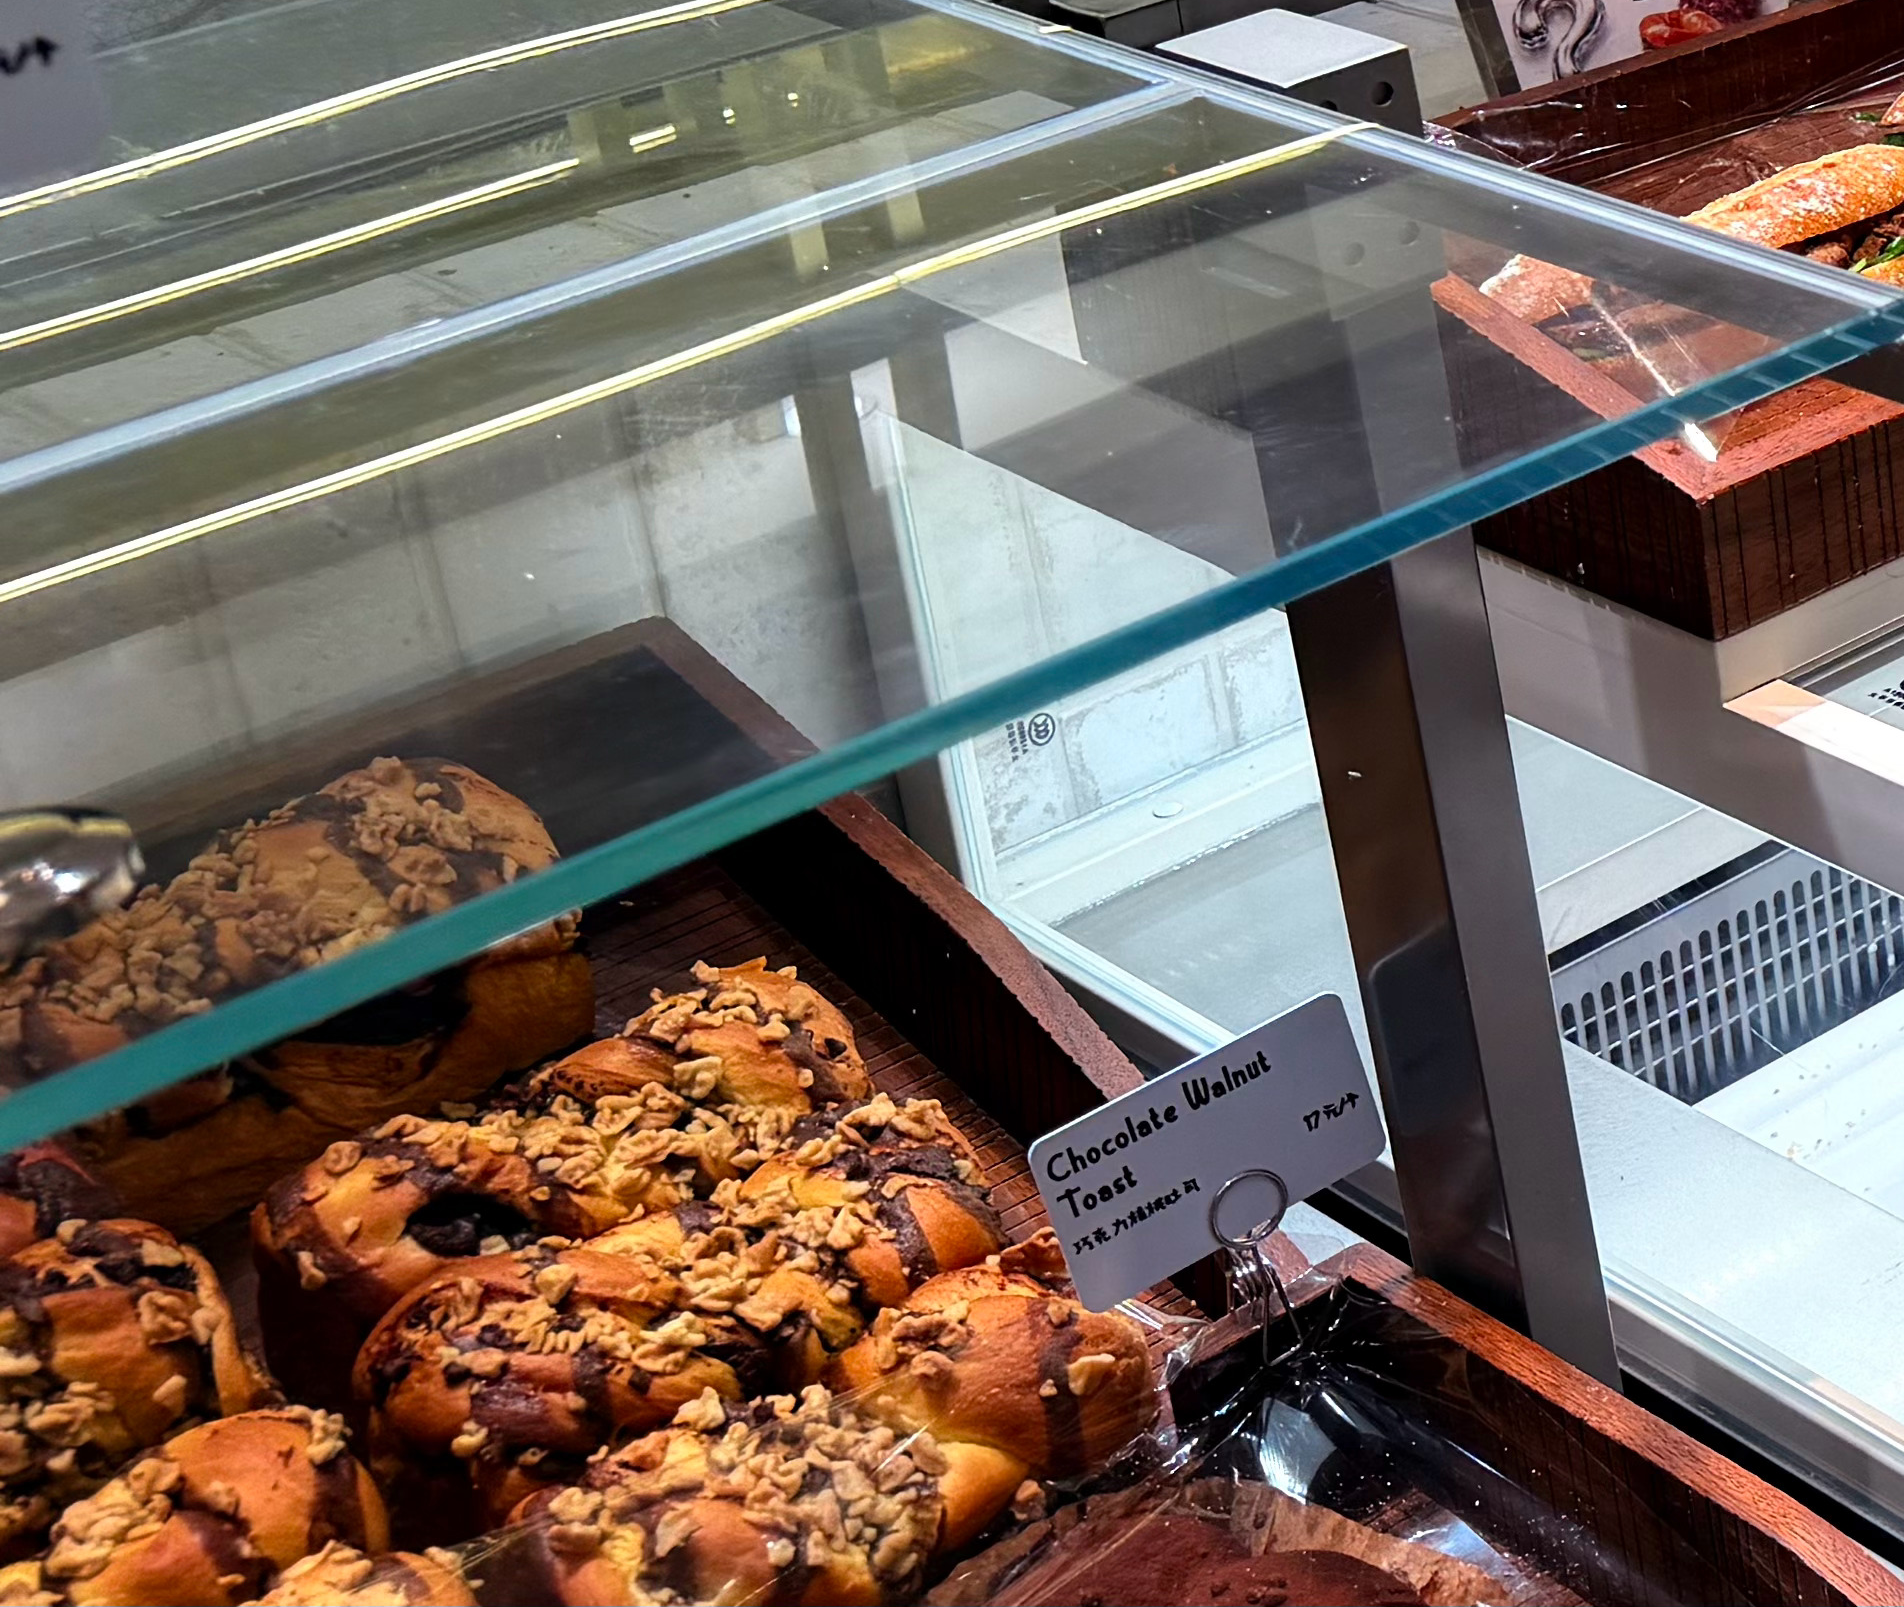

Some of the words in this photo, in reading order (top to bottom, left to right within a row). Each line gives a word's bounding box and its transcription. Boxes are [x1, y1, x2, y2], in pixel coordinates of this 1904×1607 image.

[1046, 1102, 1180, 1182] Chocolate
[1181, 1050, 1272, 1112] Walnut
[1056, 1164, 1138, 1219] Toast
